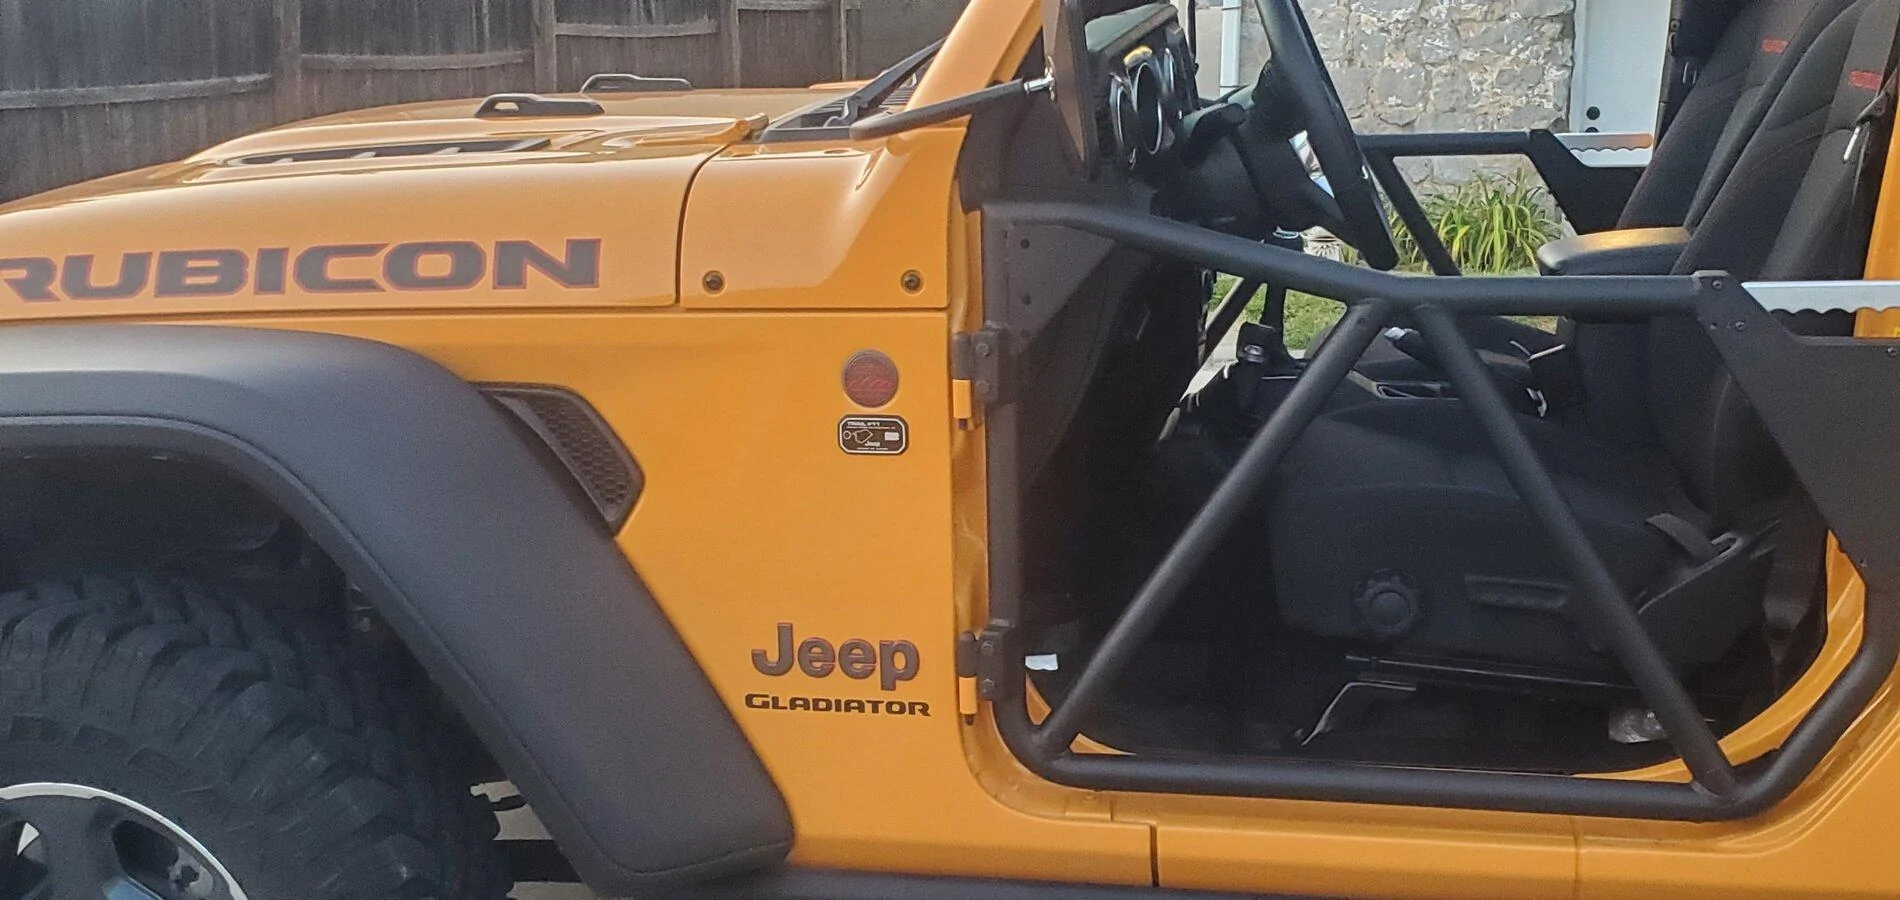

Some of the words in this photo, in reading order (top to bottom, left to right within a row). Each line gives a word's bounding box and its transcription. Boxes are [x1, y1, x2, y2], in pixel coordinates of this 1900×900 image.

[0, 238, 602, 302] RUBICON
[751, 622, 920, 691] Jeep
[745, 693, 931, 716] GLADIATOR
